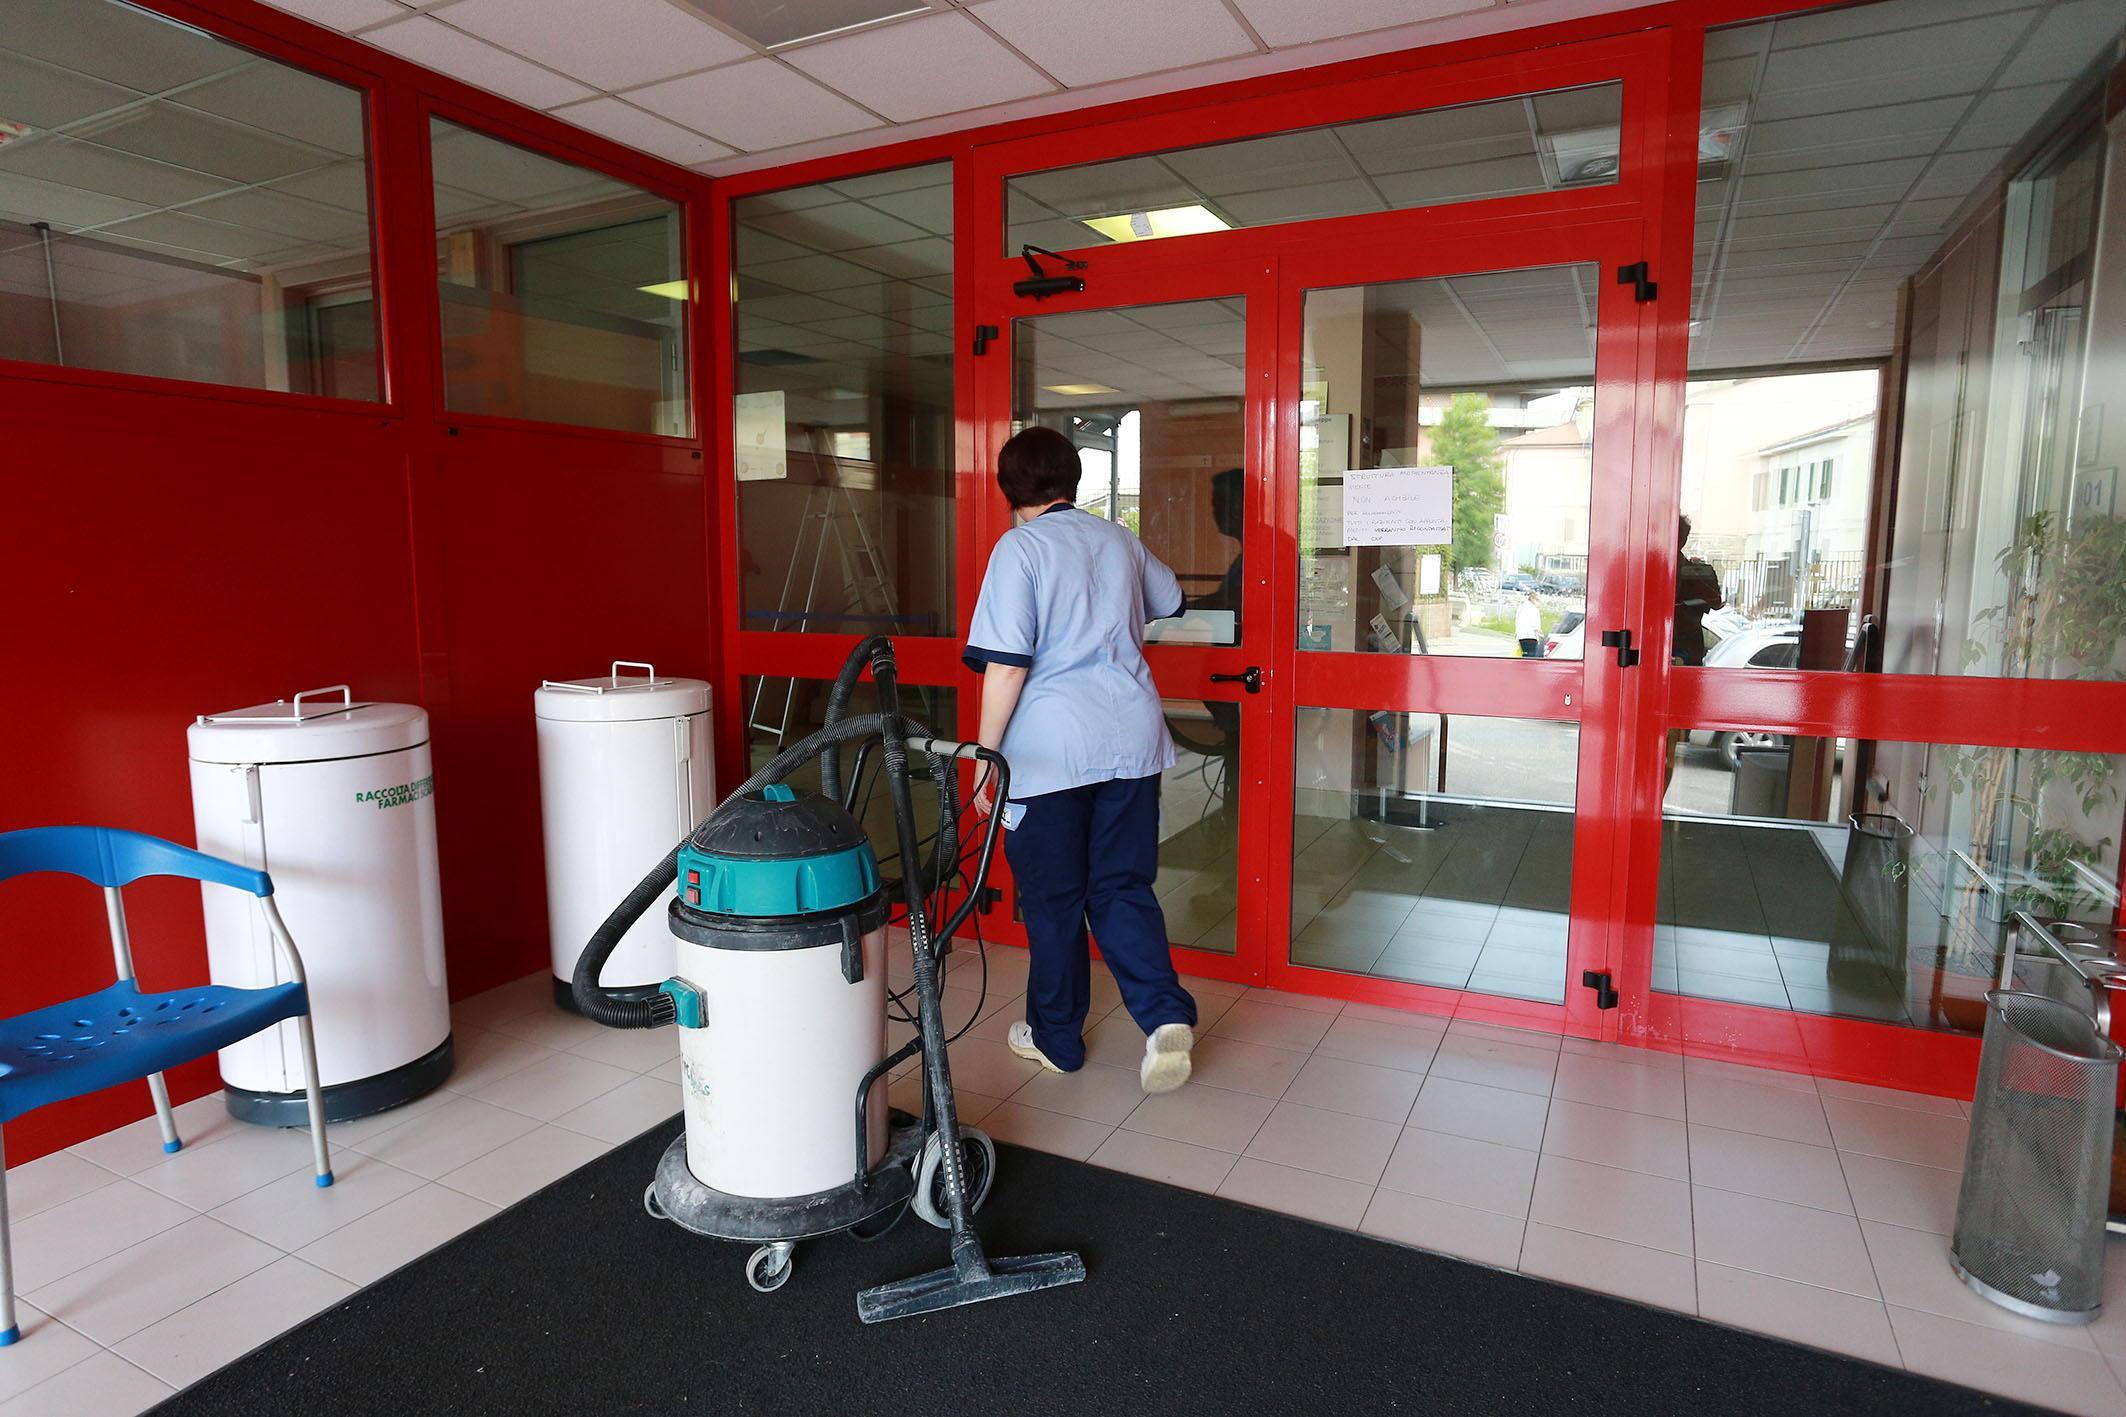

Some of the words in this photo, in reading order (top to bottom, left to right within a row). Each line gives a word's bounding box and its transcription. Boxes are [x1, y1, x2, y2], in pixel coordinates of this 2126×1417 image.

[1352, 495, 1372, 504] NON
[356, 784, 410, 802] RACCOLTA
[378, 791, 420, 810] FARMACI
